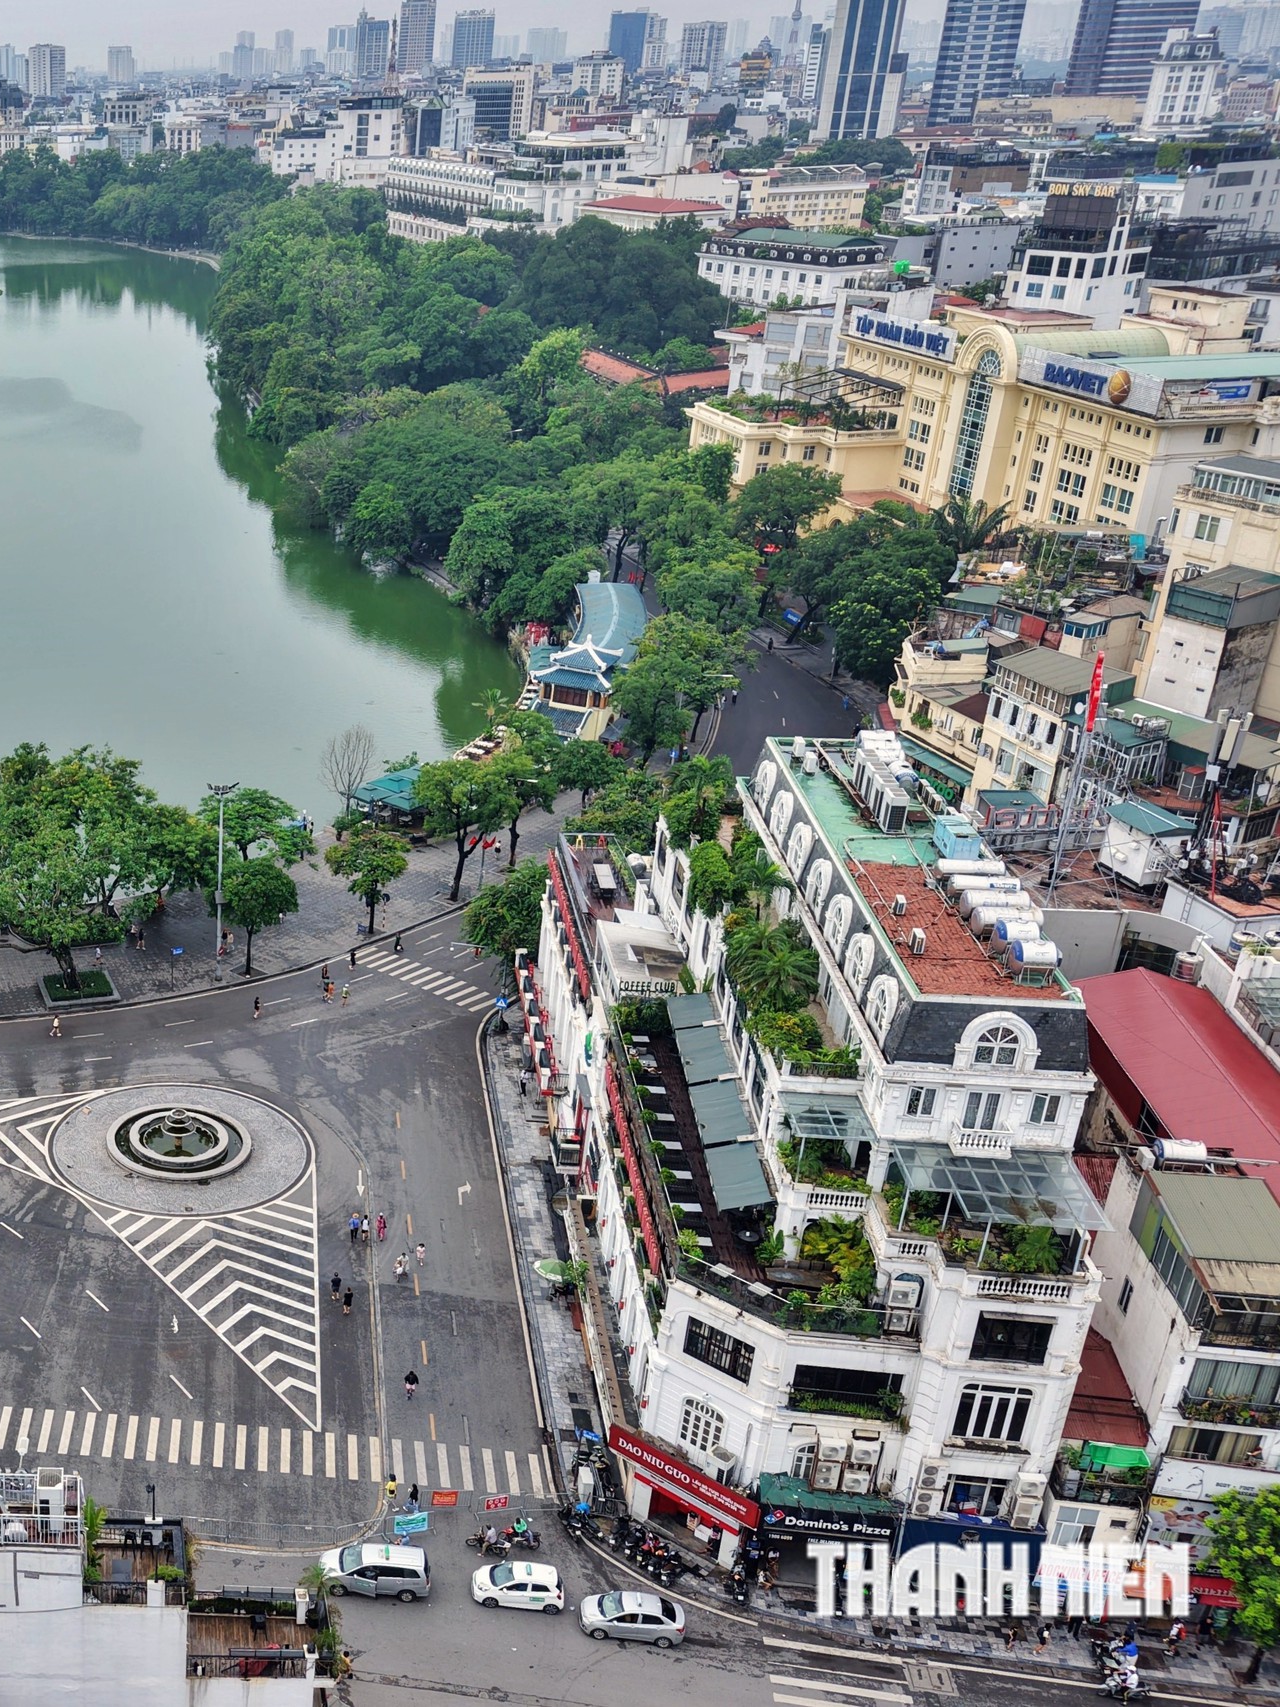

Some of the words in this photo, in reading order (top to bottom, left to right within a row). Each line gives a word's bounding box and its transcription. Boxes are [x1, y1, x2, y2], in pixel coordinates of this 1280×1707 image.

[1048, 183, 1070, 196] BON
[1071, 184, 1092, 197] SKY
[1094, 185, 1116, 198] BAR
[903, 323, 925, 347] BẢO
[925, 332, 949, 356] VIỆT
[1043, 362, 1108, 396] BAOVIET
[620, 980, 651, 991] COFFEE
[654, 981, 676, 992] CLUB
[618, 1437, 641, 1457] DAO
[642, 1451, 665, 1469] NIU
[665, 1464, 690, 1484] GUO
[784, 1515, 849, 1532] Domino's
[853, 1523, 891, 1536] Pizza
